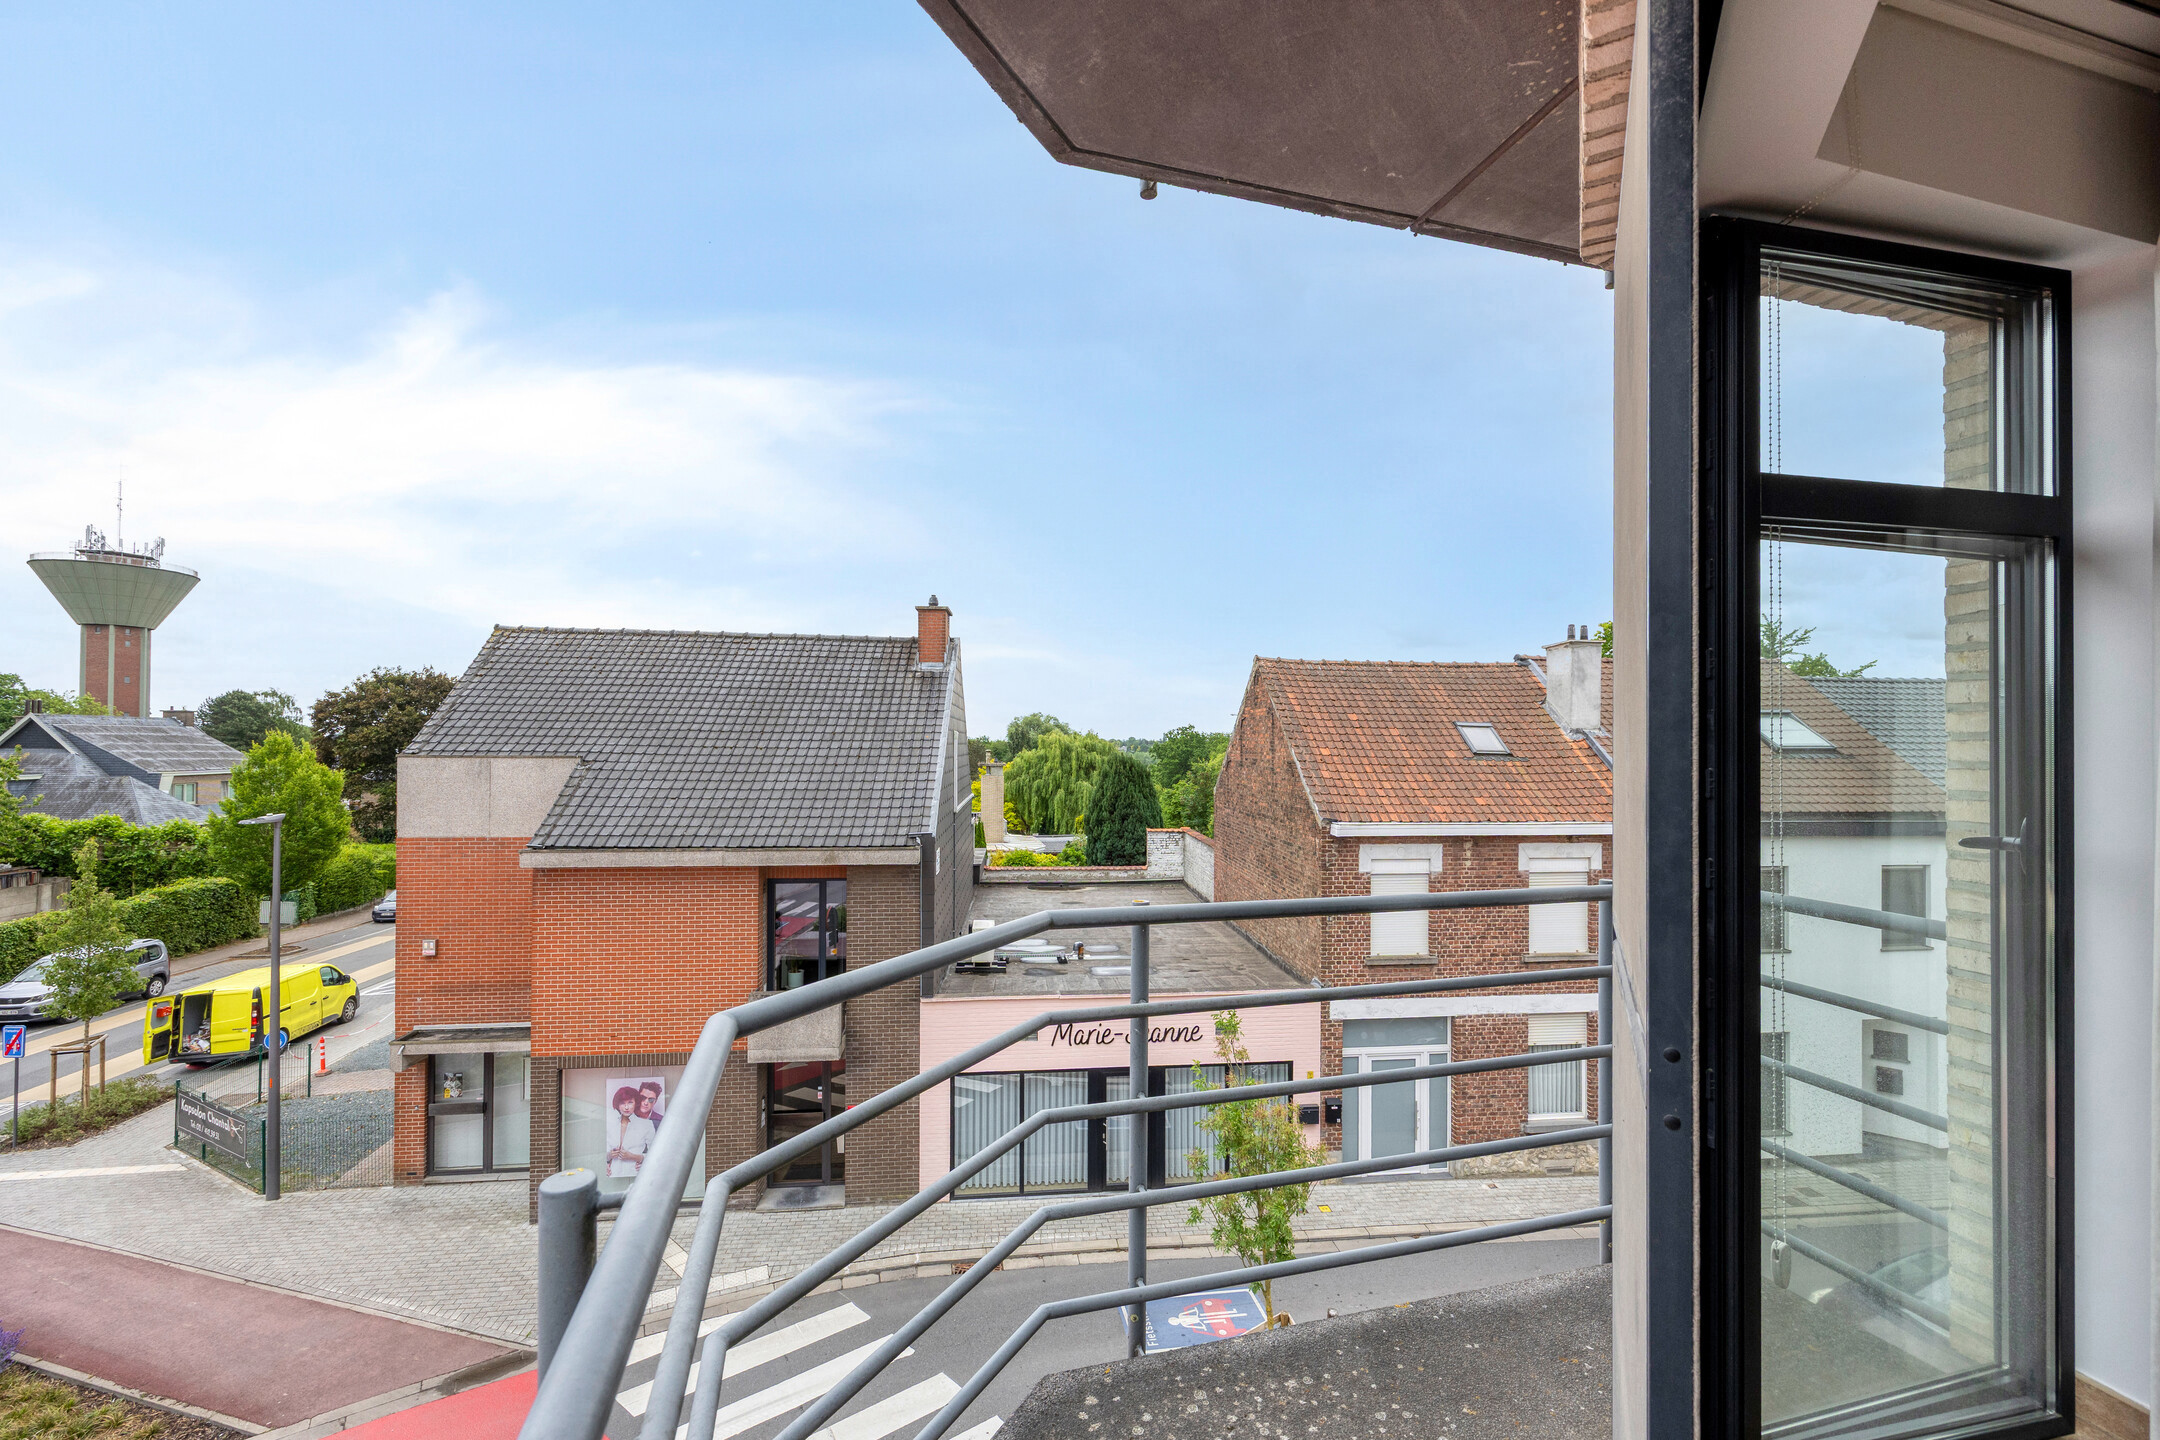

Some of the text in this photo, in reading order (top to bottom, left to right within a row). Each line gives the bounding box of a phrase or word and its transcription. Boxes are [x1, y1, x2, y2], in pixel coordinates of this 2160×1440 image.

[1051, 1022, 1203, 1047] Marie-anne
[181, 1098, 231, 1132] Kapsalon Chantal
